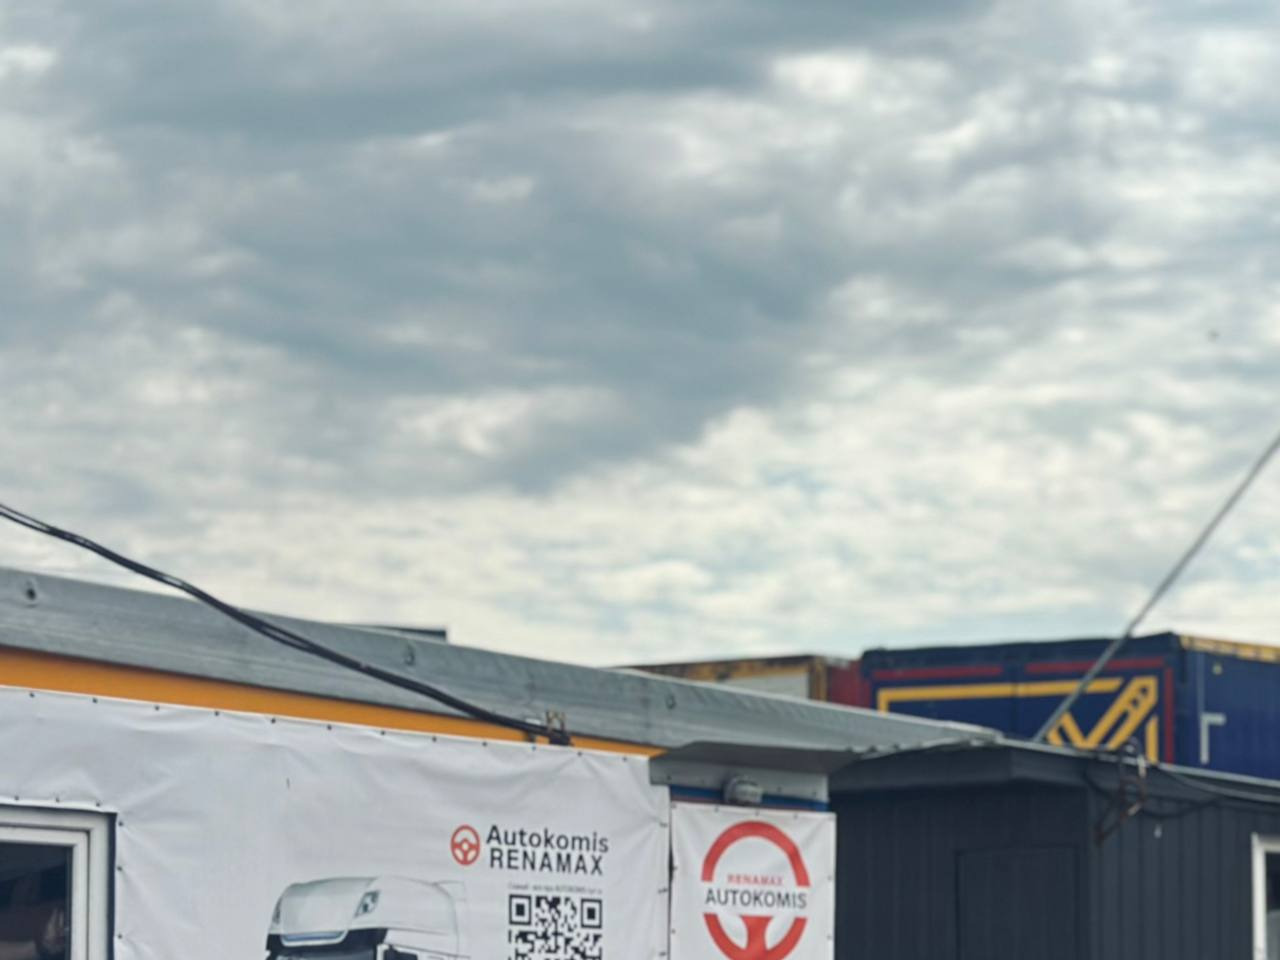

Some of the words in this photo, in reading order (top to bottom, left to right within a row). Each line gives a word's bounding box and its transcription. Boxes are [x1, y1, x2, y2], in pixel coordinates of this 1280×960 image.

[486, 824, 609, 853] Autokomis
[489, 848, 603, 876] RENAMAX
[727, 873, 784, 886] RENAMAX
[705, 887, 808, 909] AUTOKOMIS
